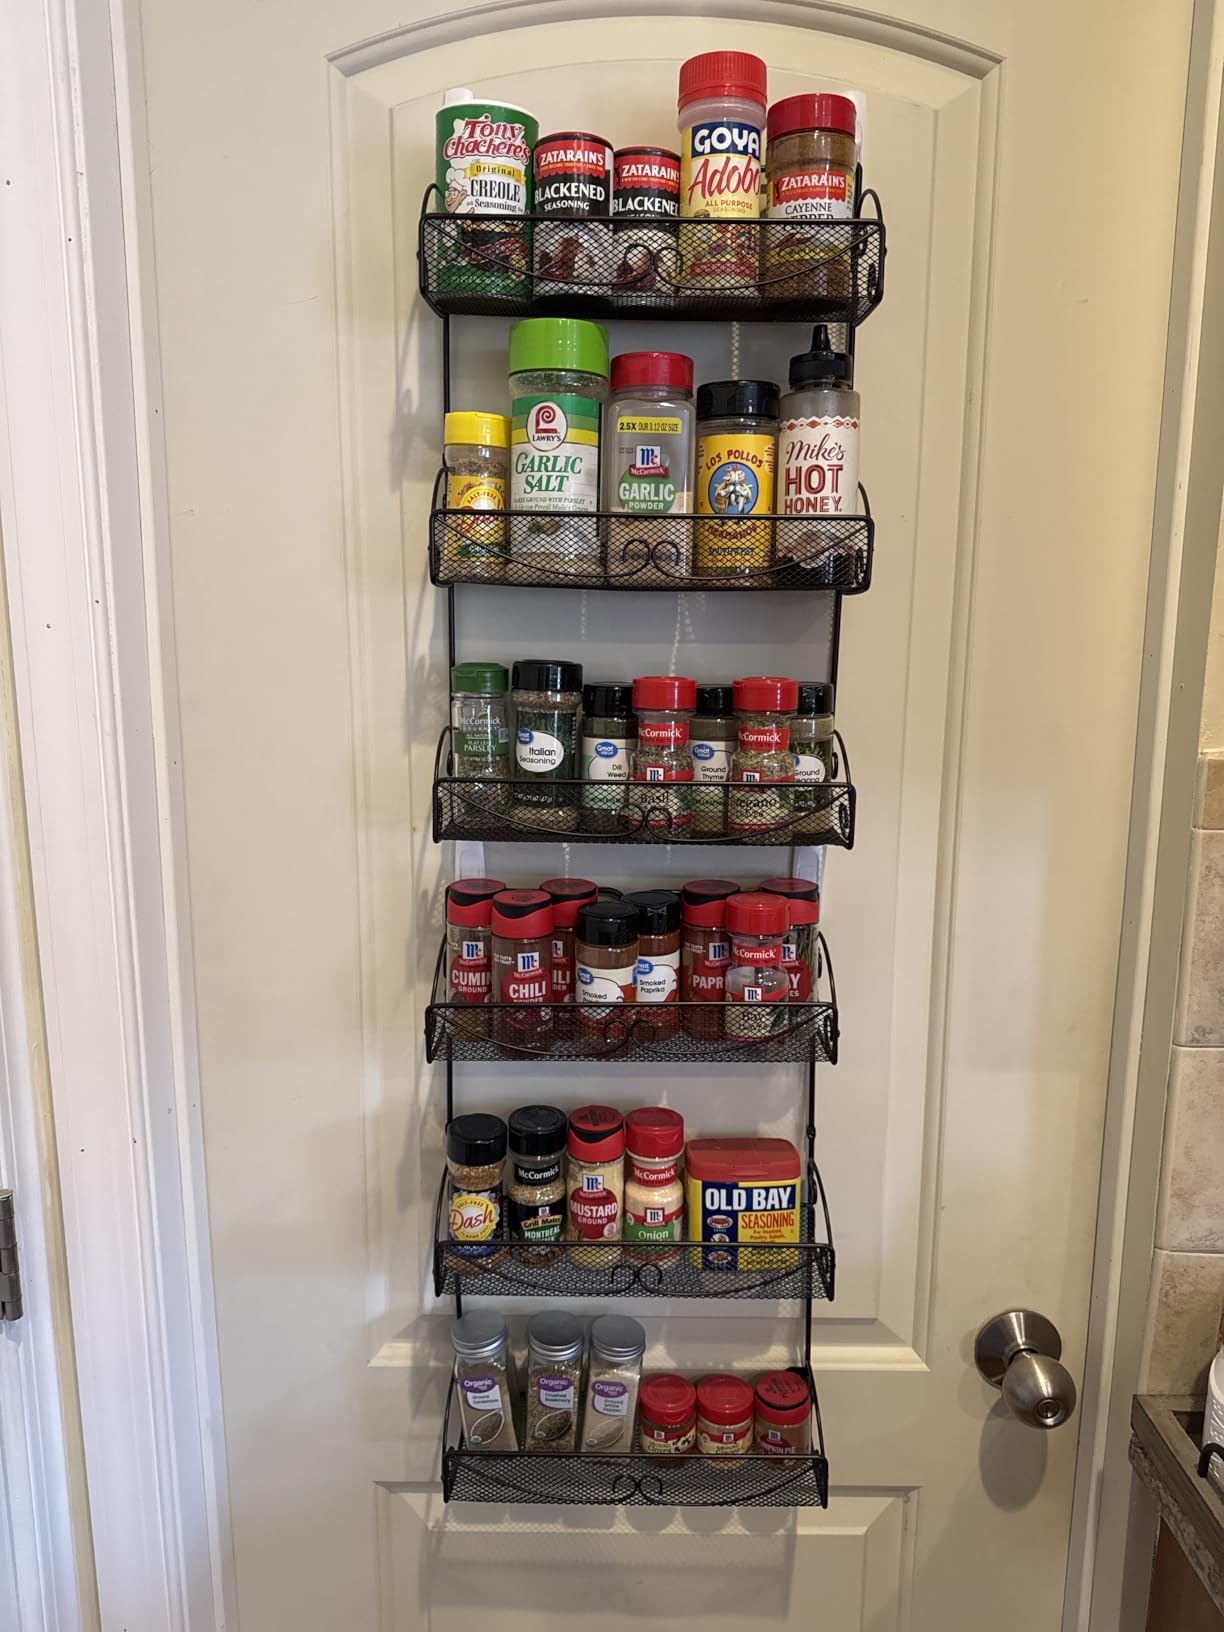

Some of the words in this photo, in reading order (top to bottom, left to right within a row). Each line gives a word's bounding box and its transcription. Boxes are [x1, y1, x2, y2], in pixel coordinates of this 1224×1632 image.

[463, 114, 523, 143] Tony
[694, 127, 760, 157] GOYA
[444, 138, 530, 165] Chachere's
[540, 149, 605, 166] ZATARAIN'S
[476, 164, 516, 177] Original
[782, 173, 845, 191] ZATARAIN'S
[471, 179, 520, 203] CREOLE
[535, 182, 606, 205] BLACKENED
[474, 199, 518, 212] Seasoning
[544, 200, 591, 212] SEASONING
[705, 200, 719, 208] ALL
[721, 199, 753, 210] PURPOSE
[785, 203, 832, 215] CAYENNE
[619, 422, 637, 431] 2.5X
[638, 423, 648, 431] OUR
[668, 424, 680, 432] SIZE
[532, 434, 562, 443] LAWRY'S
[785, 433, 847, 465] Mike's
[515, 451, 583, 475] GARLIC
[706, 452, 722, 470] LOS
[727, 448, 764, 469] POLLOS
[523, 475, 570, 495] SALT
[785, 463, 844, 497] HOT
[619, 483, 675, 501] GARLIC
[628, 501, 665, 511] POWDER
[784, 496, 842, 515] HONEY
[528, 746, 556, 757] Italian
[519, 755, 557, 767] Seasoning
[700, 765, 727, 773] Ground
[702, 773, 725, 782] Thyme
[508, 980, 547, 998] CHILI
[639, 978, 667, 987] Smoked
[640, 985, 666, 994] Paprika
[692, 974, 725, 990] PAPR
[582, 989, 608, 1000] Smoked
[517, 1165, 560, 1180] McCormick
[634, 1166, 677, 1181] McCormick
[704, 1187, 747, 1211] OLD
[751, 1186, 793, 1210] BAY
[570, 1199, 618, 1217] MUSTARD
[449, 1203, 494, 1232] Dash
[523, 1217, 540, 1229] Grill
[577, 1216, 608, 1225] GROUND
[741, 1211, 796, 1230] SEASONING
[524, 1225, 561, 1240] MONTREAL
[638, 1230, 670, 1241] Onion
[463, 1379, 493, 1388] Organic
[539, 1377, 569, 1388] Organic
[594, 1382, 625, 1394] Organic
